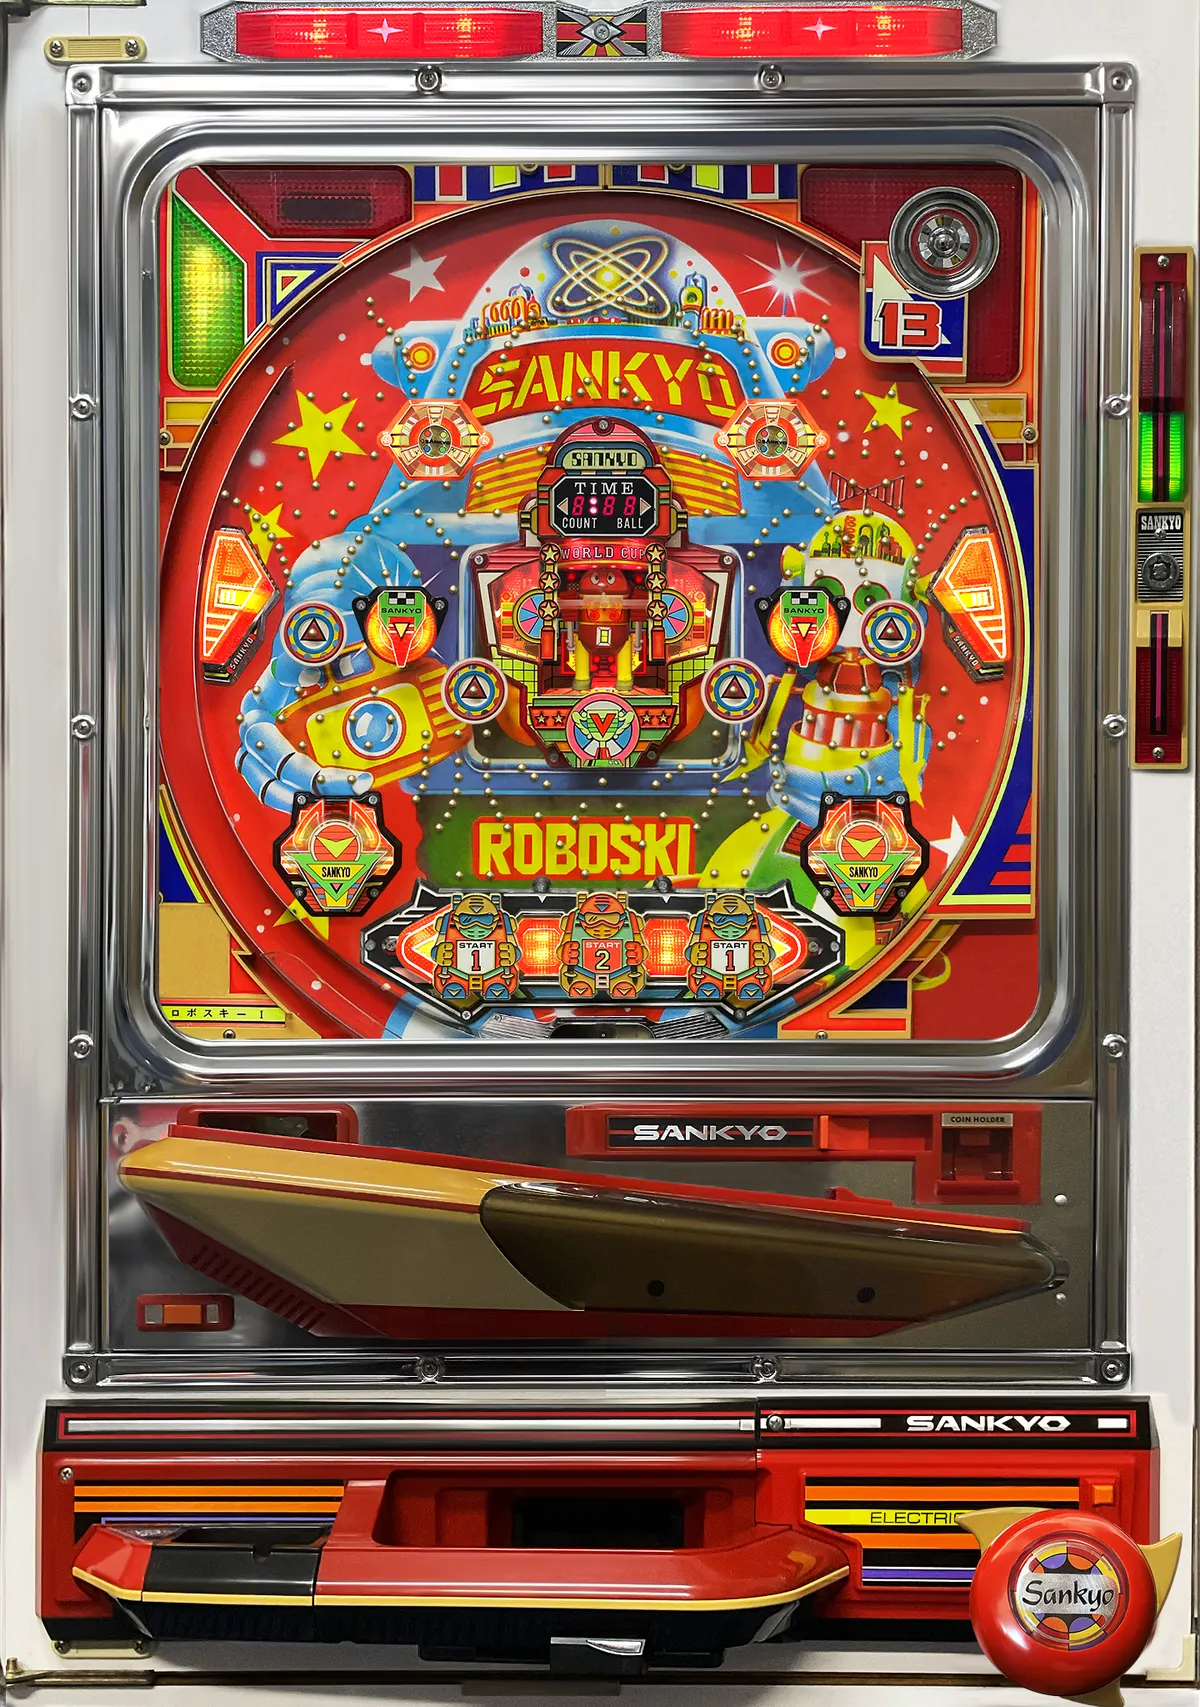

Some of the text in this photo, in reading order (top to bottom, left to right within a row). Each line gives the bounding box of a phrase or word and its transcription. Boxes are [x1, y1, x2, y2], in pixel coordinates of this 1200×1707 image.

[879, 300, 943, 350] 13
[472, 349, 737, 419] SANKYO
[574, 481, 635, 495] TIME
[561, 517, 644, 530] COUNT BALL
[1140, 514, 1182, 531] SANKYO
[561, 546, 645, 560] WORLD CUP
[380, 606, 422, 615] SANKYO
[783, 606, 826, 615] SANKYO
[229, 636, 255, 671] SANKYO
[952, 634, 980, 667] SANKYO
[477, 821, 692, 876] ROBOSKI
[321, 866, 352, 879] SANKYO
[849, 866, 879, 879] SANKYO
[458, 941, 494, 949] START
[585, 941, 621, 949] START
[713, 941, 749, 949] START
[470, 950, 483, 972] 1
[594, 949, 611, 971] 2
[725, 950, 738, 972] 1
[171, 1008, 247, 1018] ロボスキー
[973, 1116, 1006, 1124] HOLDER
[633, 1123, 788, 1142] SANKYO
[906, 1415, 1071, 1432] SANKYO
[1021, 1579, 1115, 1612] Sankyo
